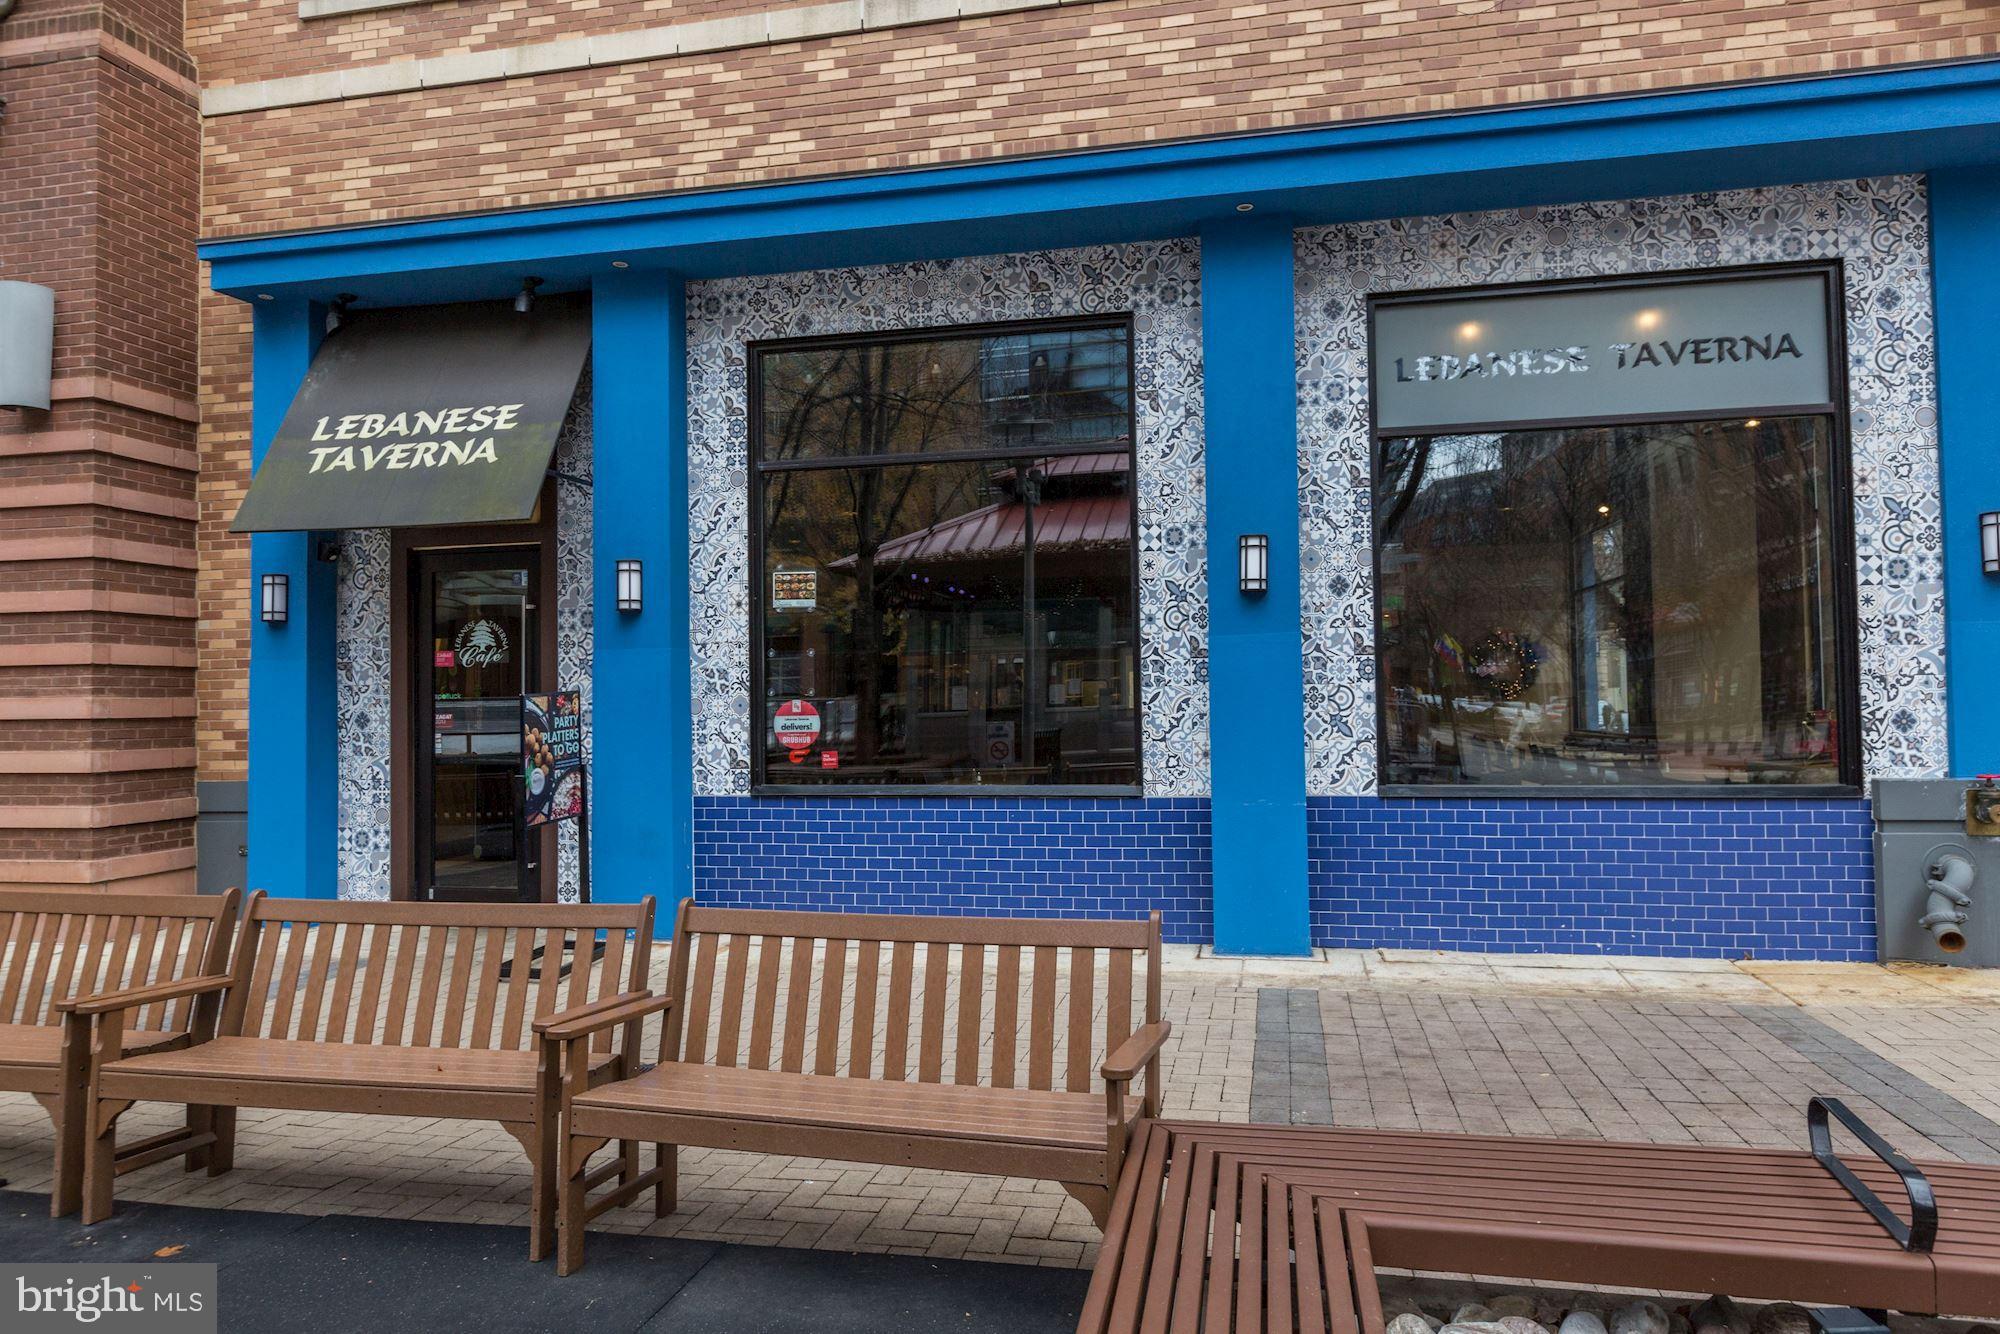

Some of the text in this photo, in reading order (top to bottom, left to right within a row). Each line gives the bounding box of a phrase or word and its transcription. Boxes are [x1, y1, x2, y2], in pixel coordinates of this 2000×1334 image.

[1394, 332, 1804, 383] LEBANESE TAVERNA
[310, 403, 525, 442] LEBANESE
[308, 437, 499, 474] TAVERNA
[454, 620, 509, 652] LEBANESE TAVERNA
[459, 646, 504, 668] Café
[554, 714, 579, 729] PARTY
[542, 728, 579, 744] PLATTERS
[553, 741, 580, 756] TO GO
